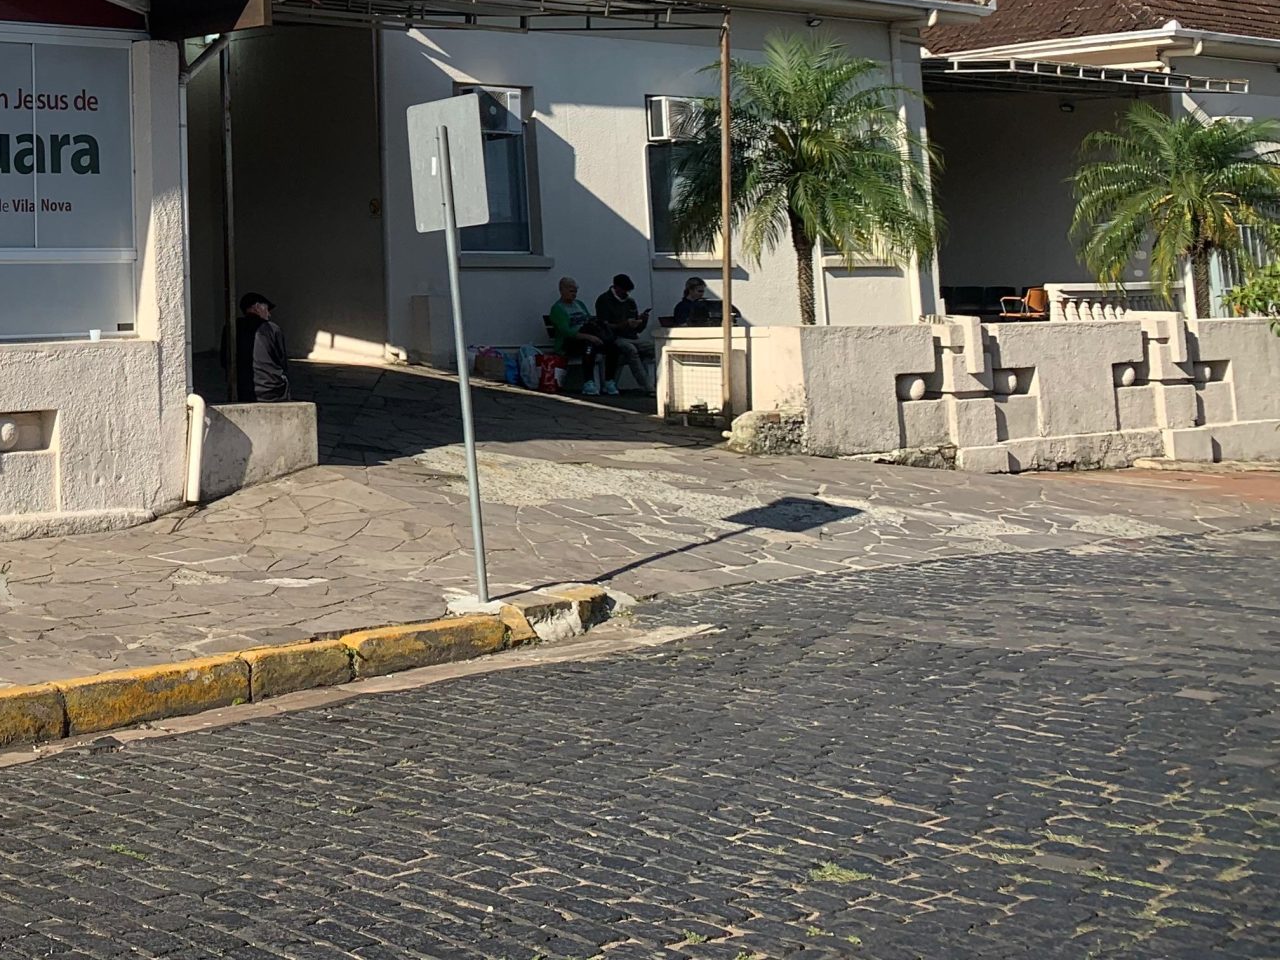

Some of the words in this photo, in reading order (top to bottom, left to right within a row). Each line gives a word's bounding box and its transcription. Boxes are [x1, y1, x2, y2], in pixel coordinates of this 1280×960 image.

[13, 88, 69, 110] Jesus
[73, 89, 99, 111] de
[12, 198, 36, 213] Vila
[40, 198, 72, 212] Nova
